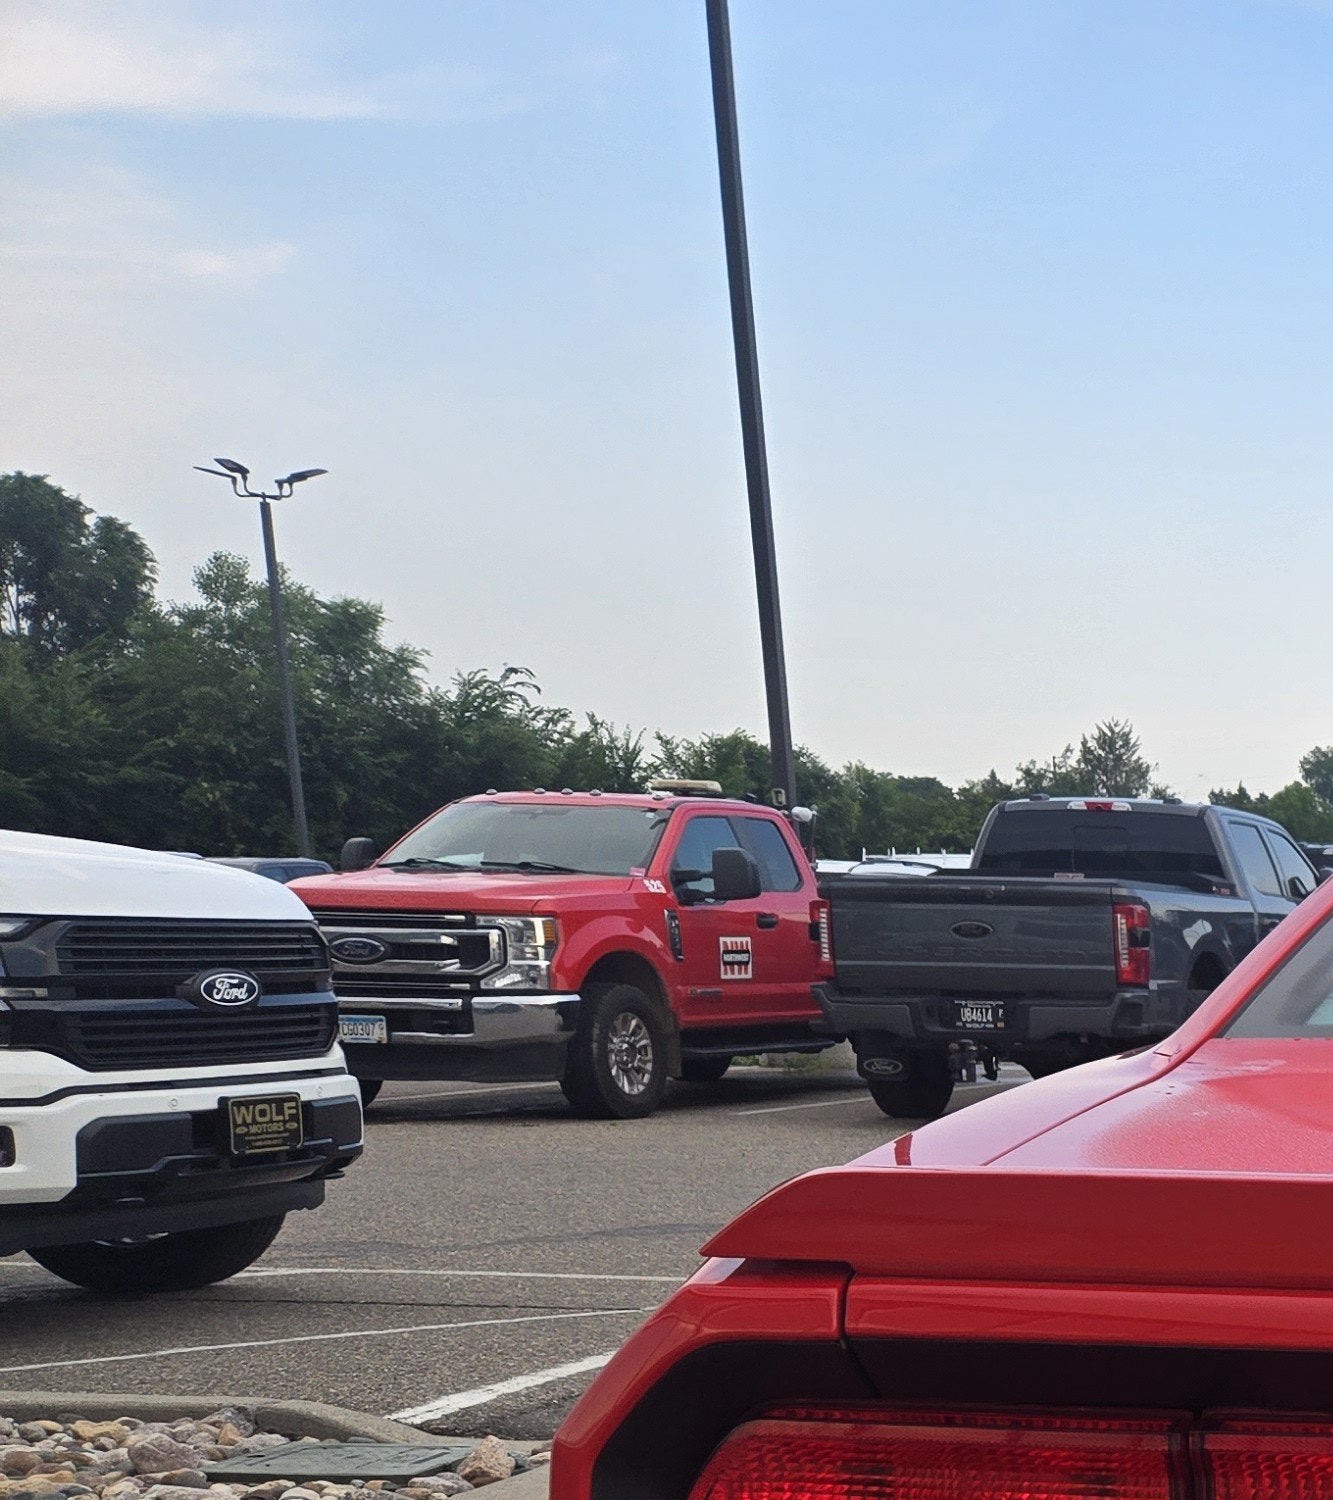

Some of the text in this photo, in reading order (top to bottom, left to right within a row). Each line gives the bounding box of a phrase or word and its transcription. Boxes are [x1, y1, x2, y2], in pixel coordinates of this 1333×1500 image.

[213, 978, 248, 999] Ford
[232, 1101, 298, 1125] WOLF
[249, 1122, 285, 1134] MOTORS
